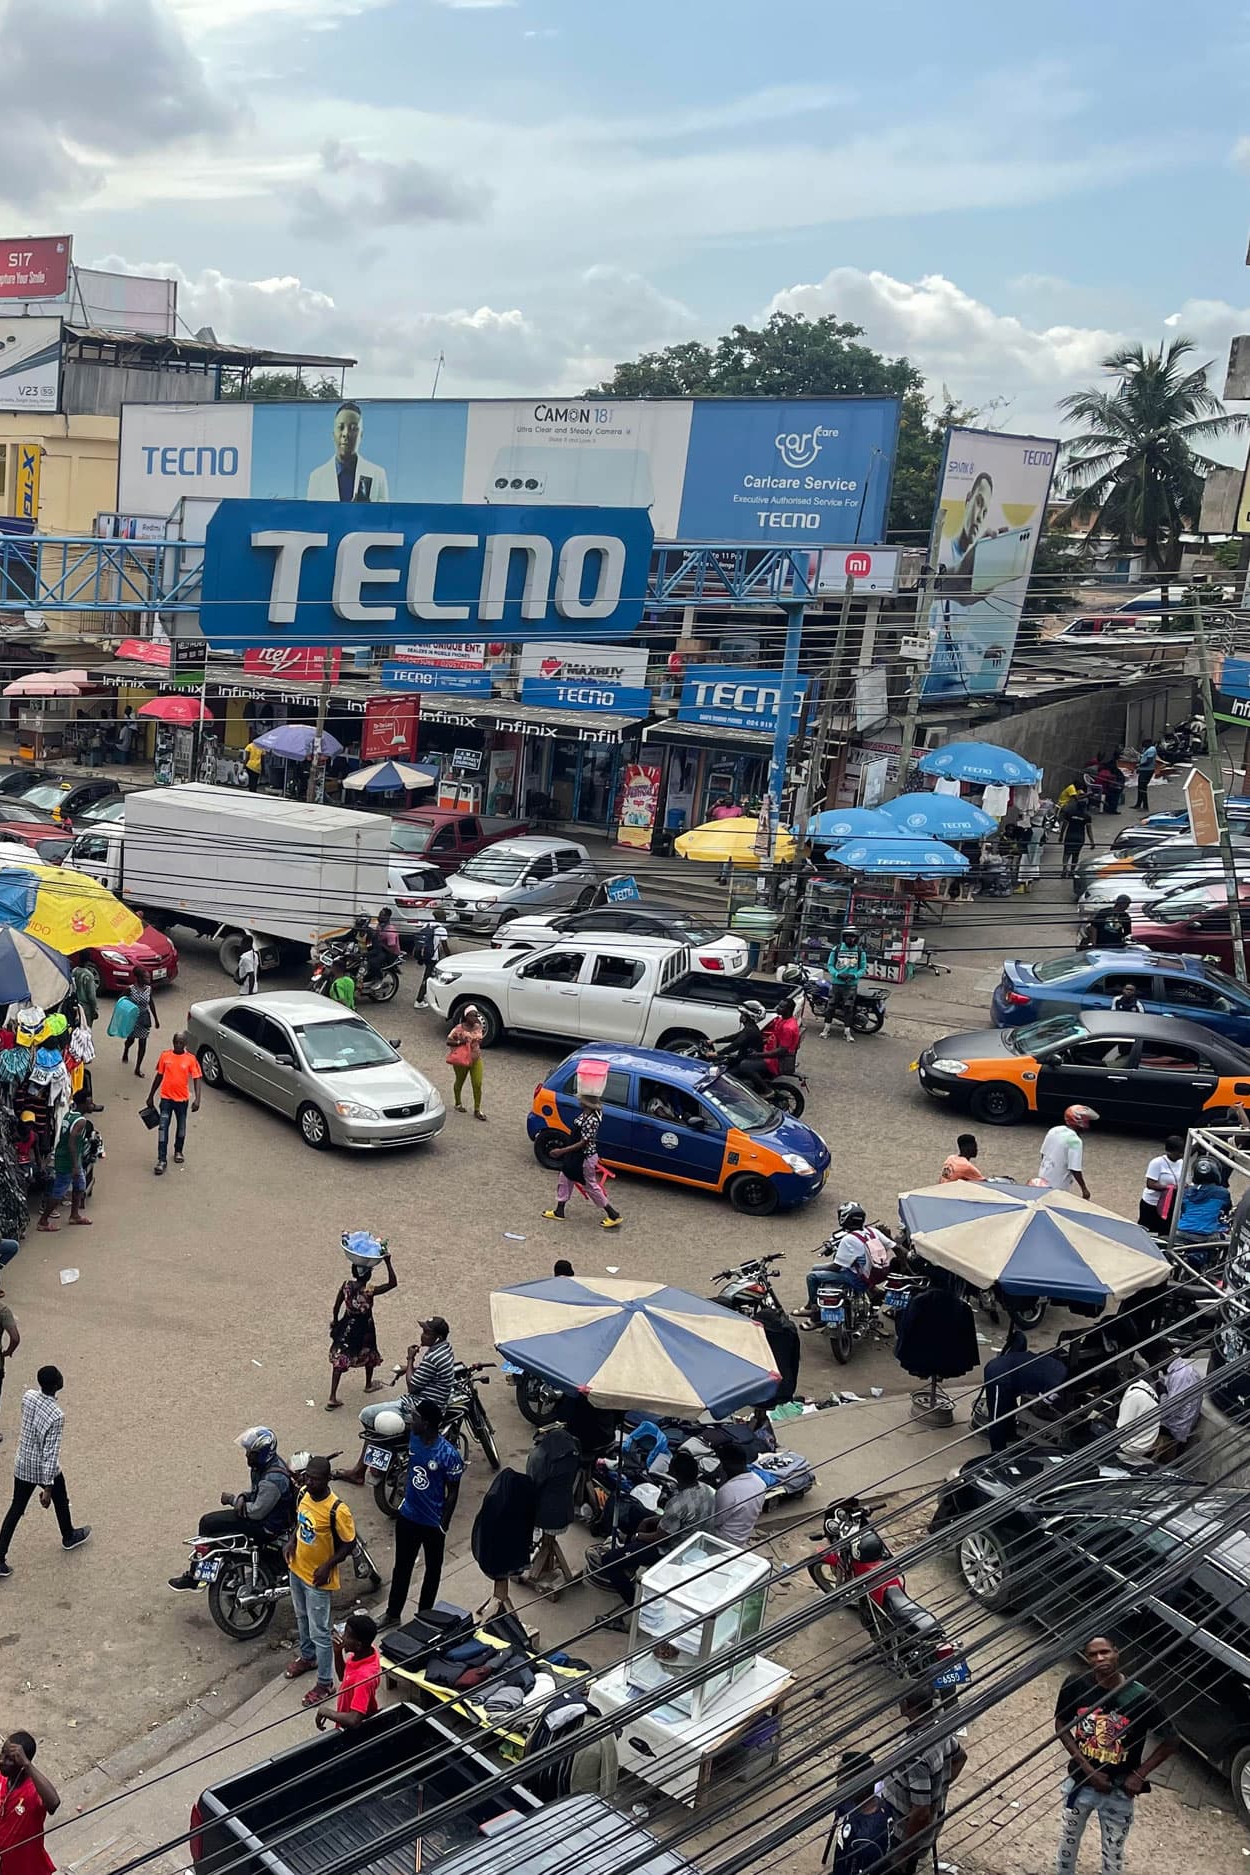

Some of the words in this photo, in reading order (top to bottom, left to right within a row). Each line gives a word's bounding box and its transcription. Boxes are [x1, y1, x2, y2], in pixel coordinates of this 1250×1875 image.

[16, 271, 29, 284] Your
[29, 270, 46, 283] Smile
[18, 386, 39, 396] V23
[534, 404, 590, 423] CAMON
[535, 426, 552, 434] Clear
[554, 426, 568, 434] and
[570, 427, 593, 436] Steady
[817, 429, 839, 438] care
[142, 446, 239, 476] TECNO
[1022, 450, 1053, 467] TECNO
[743, 475, 801, 489] Carlcare
[804, 476, 857, 490] Service
[733, 494, 769, 504] Executive
[770, 496, 812, 505] Authorised
[813, 497, 843, 507] Service
[844, 499, 860, 508] For
[757, 511, 821, 529] TECNO
[251, 531, 627, 623] TECNO
[102, 675, 148, 690] Infinix
[393, 671, 433, 685] TECNO
[218, 685, 267, 701] Infinix
[556, 686, 615, 706] TECNO
[418, 709, 477, 728] Infinix
[495, 719, 559, 738] Infinix
[962, 765, 993, 775] TECNO
[877, 858, 911, 866] TECNO
